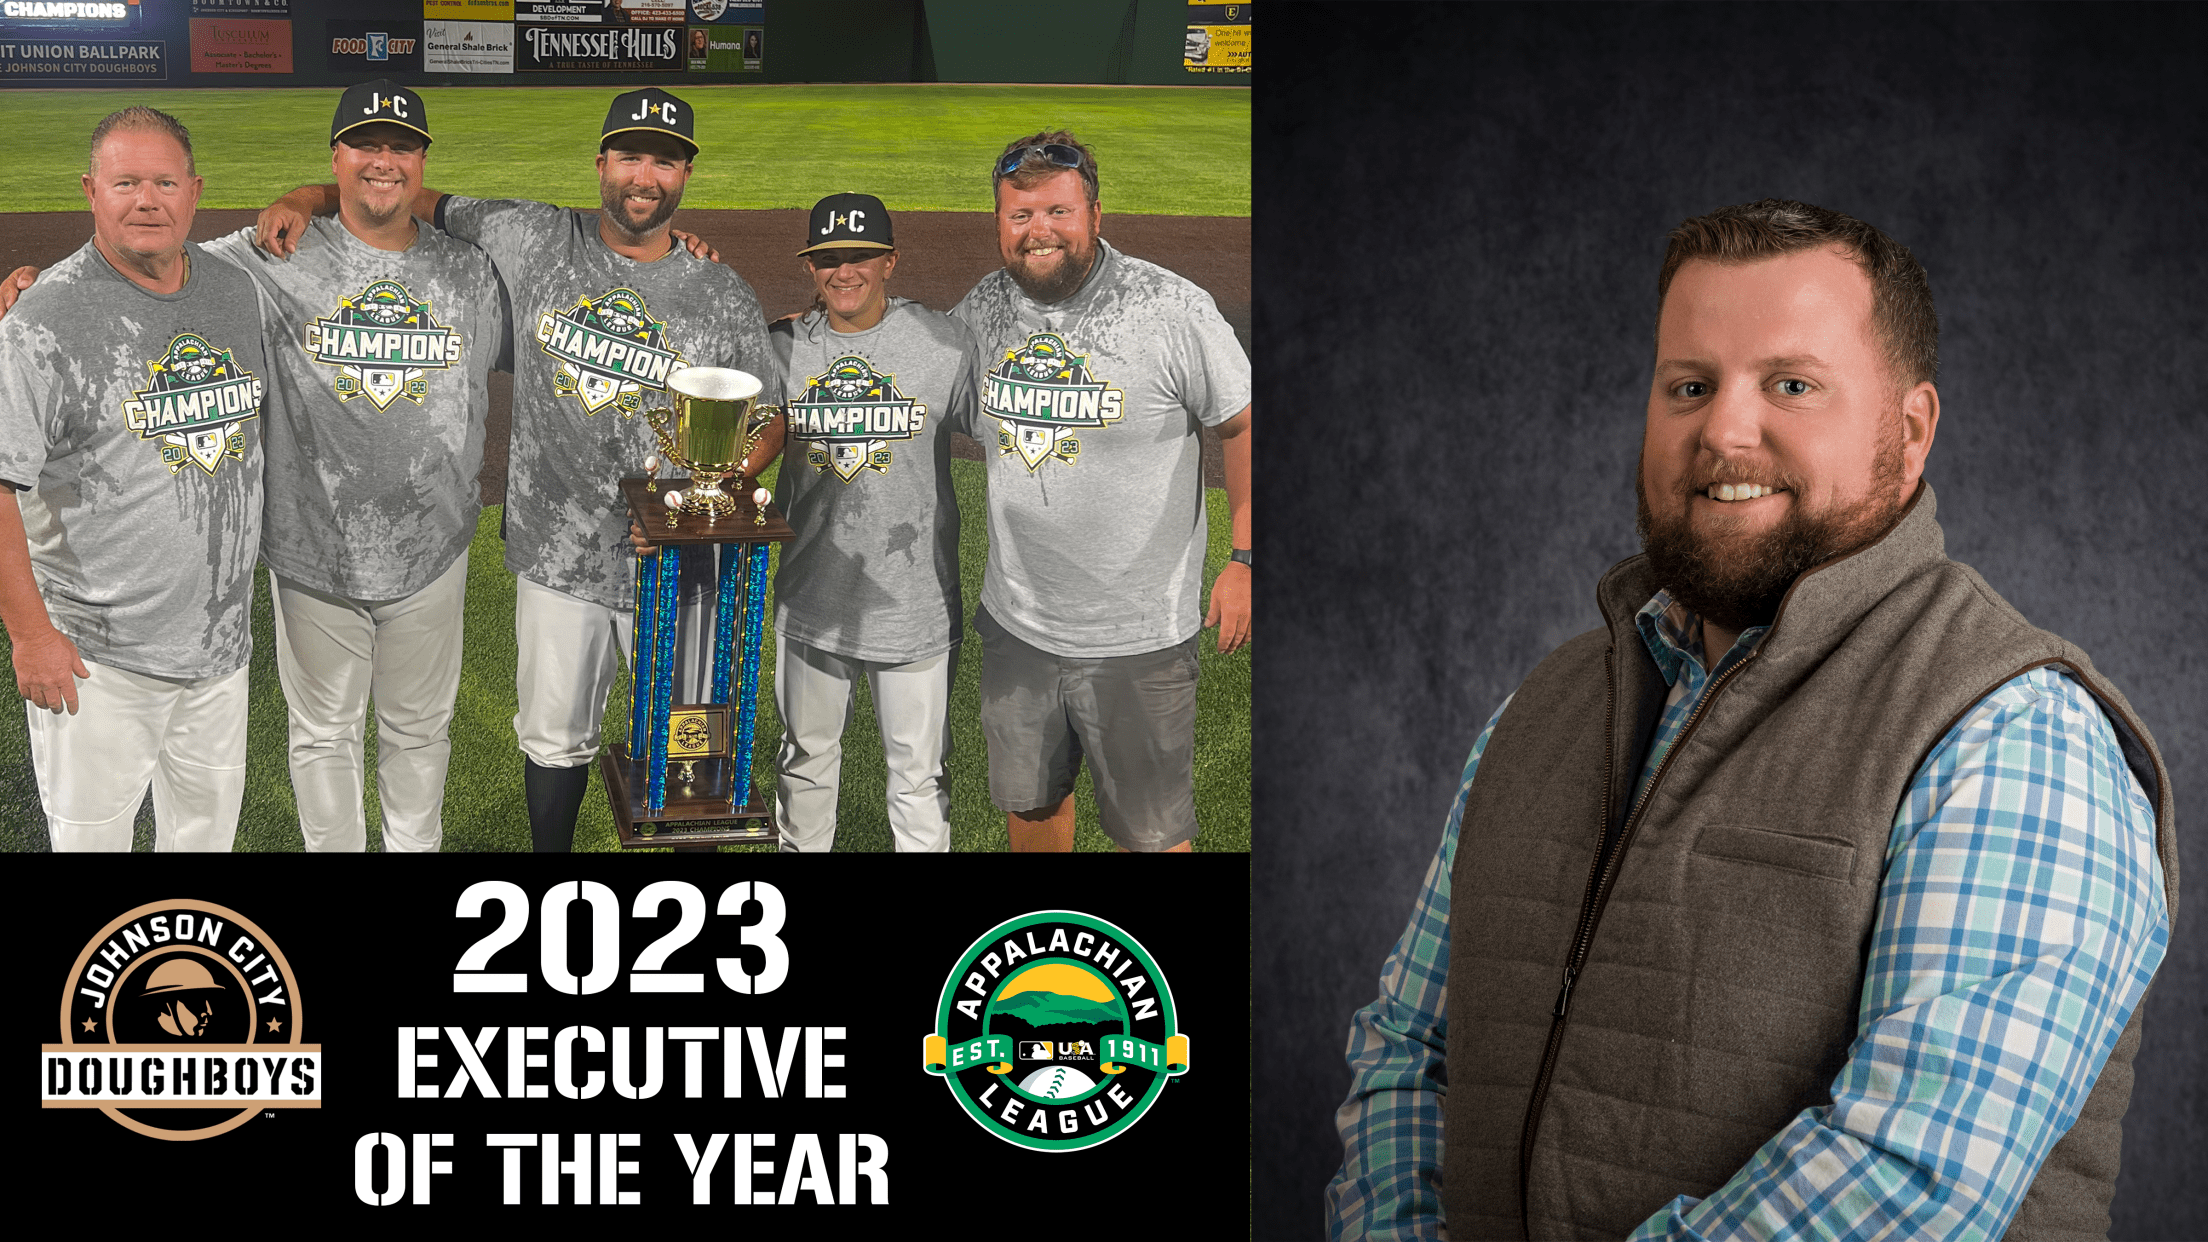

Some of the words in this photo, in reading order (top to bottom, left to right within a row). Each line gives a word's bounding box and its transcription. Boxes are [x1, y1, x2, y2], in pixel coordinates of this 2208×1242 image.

[4, 1, 126, 18] CHAMPIONS
[532, 4, 586, 13] DEVELOPMENT
[426, 27, 446, 39] Visit
[20, 45, 74, 59] UNION
[79, 46, 160, 59] BALLPARK
[332, 38, 367, 54] FOOD
[387, 38, 415, 54] CITY
[427, 42, 460, 51] General
[462, 43, 485, 51] Shale
[525, 28, 619, 62] TENNESSEE
[621, 28, 676, 61] HILLS
[709, 41, 741, 50] Humana
[5, 63, 61, 73] JOHNSON
[63, 63, 87, 73] CITY
[89, 63, 157, 73] DOUGHBOYS
[304, 323, 462, 361] CHAMPIONS
[337, 378, 354, 391] 20
[411, 381, 427, 394] 23
[556, 373, 571, 388] 20
[622, 393, 640, 409] 23
[123, 379, 262, 430] CHAMPIONS
[163, 447, 182, 462] 20
[231, 435, 244, 449] 23
[1060, 440, 1079, 454] 23
[809, 452, 825, 464] 20
[873, 452, 891, 465] 23
[689, 825, 730, 833] CHAMPIONS
